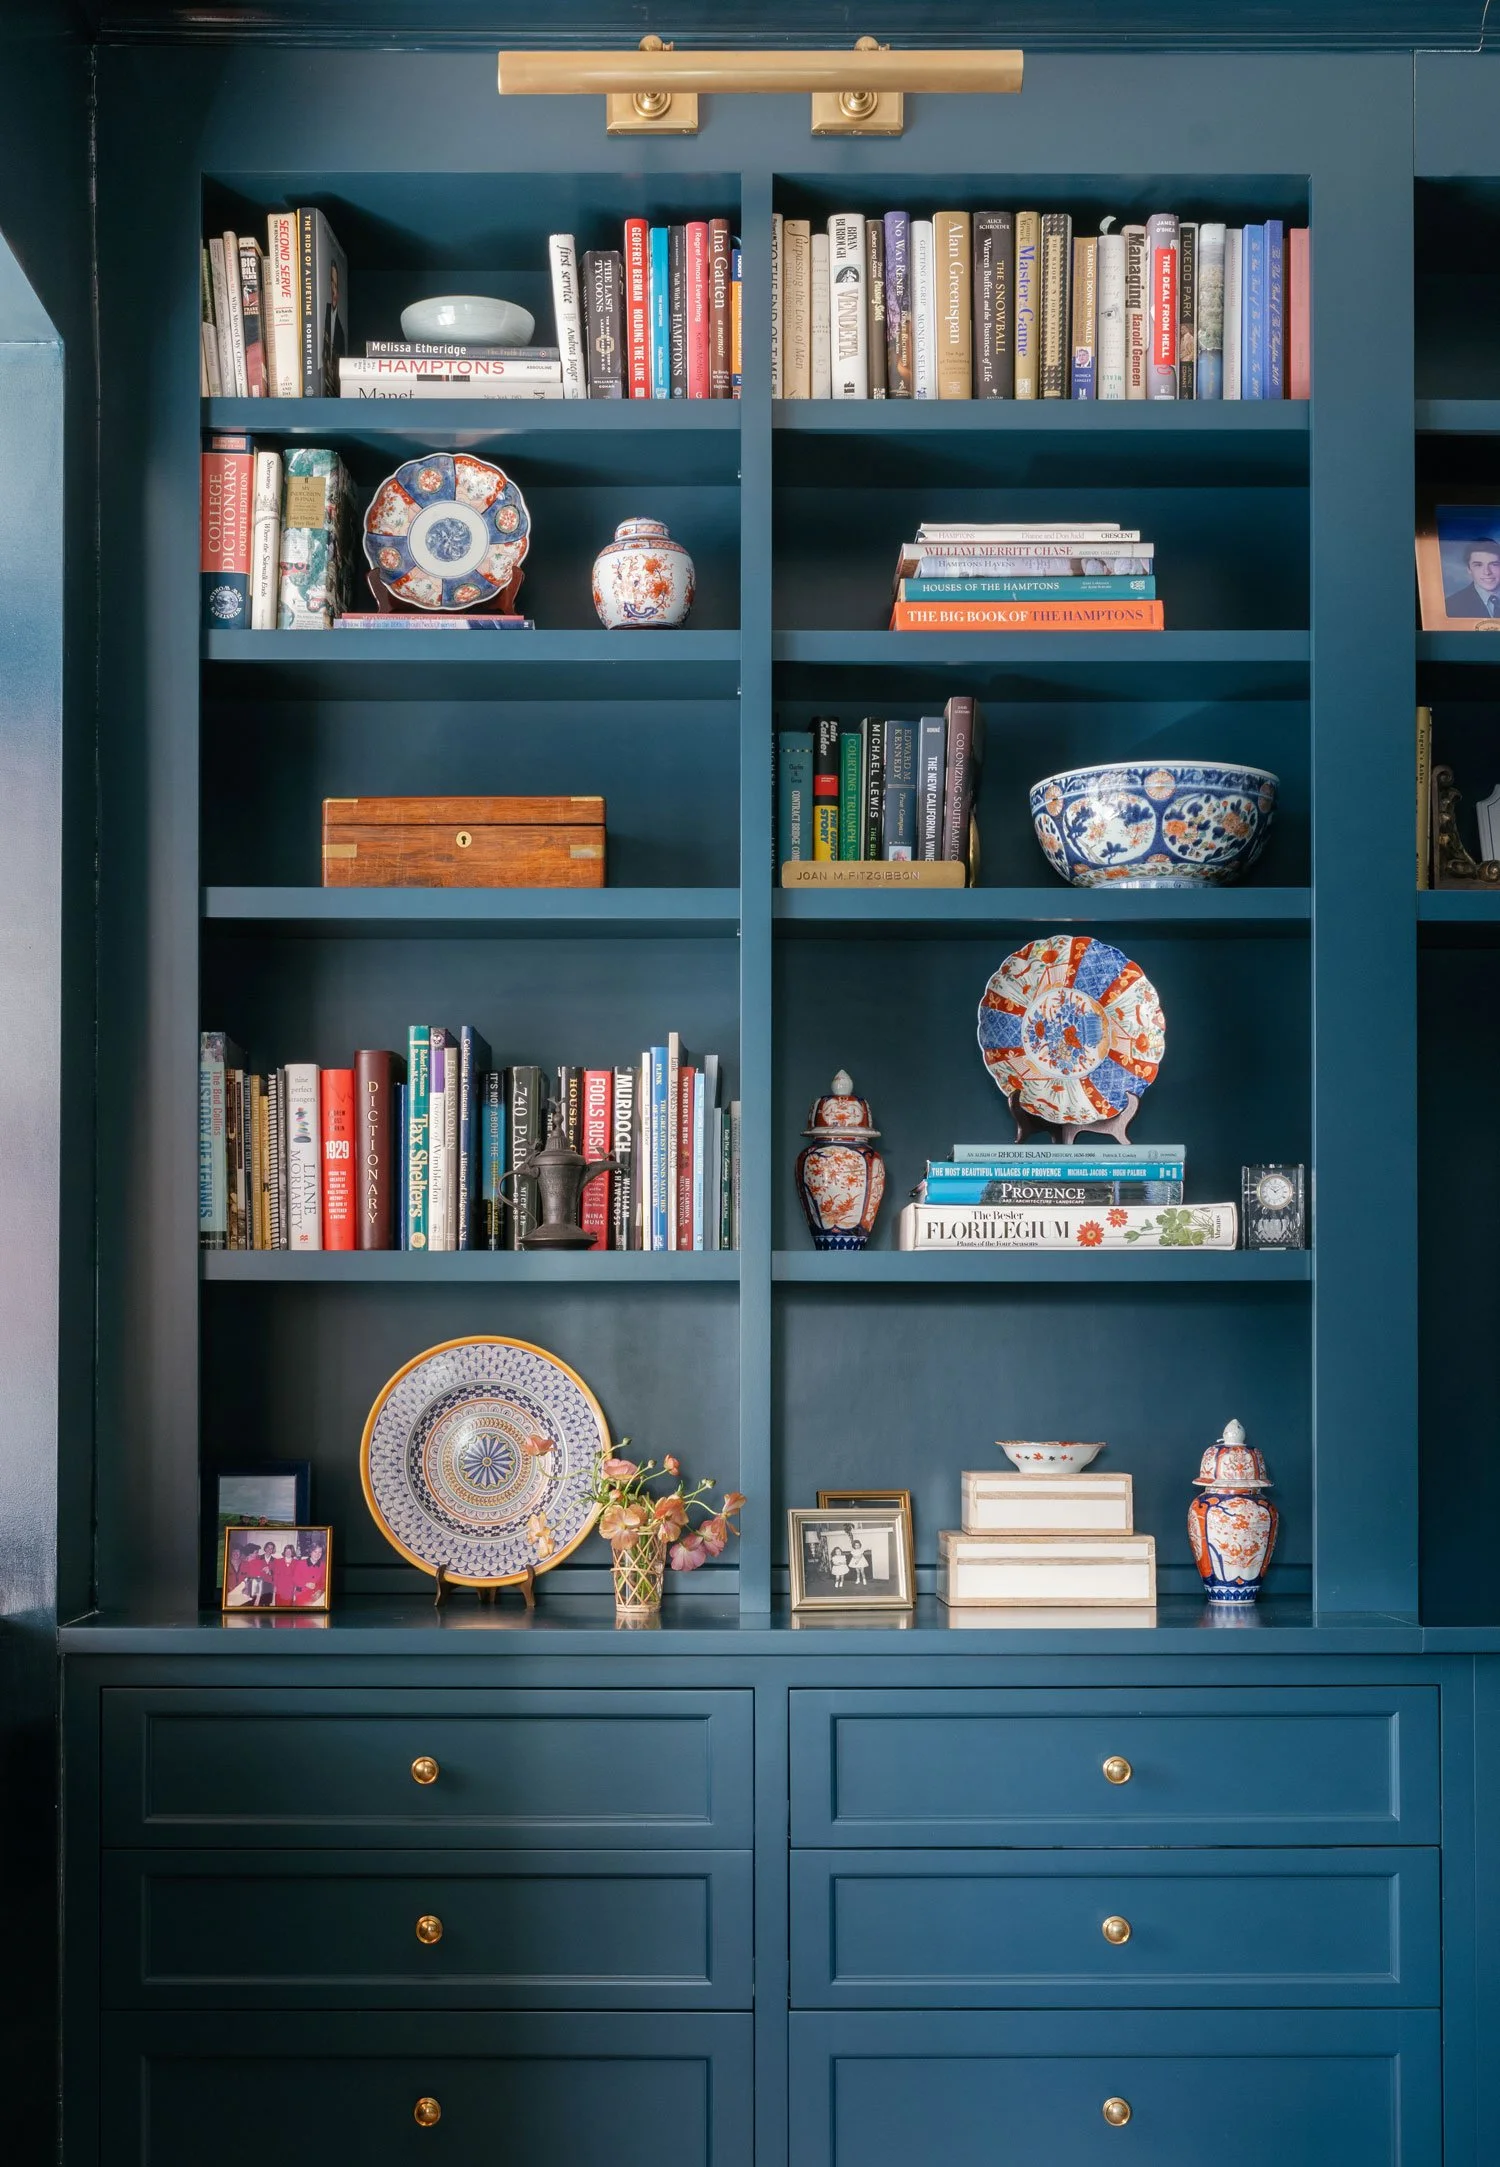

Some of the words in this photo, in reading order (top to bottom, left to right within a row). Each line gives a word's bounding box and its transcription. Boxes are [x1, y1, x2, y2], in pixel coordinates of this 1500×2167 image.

[280, 219, 290, 260] SECOND
[632, 227, 641, 266] GEOFFREY
[714, 229, 727, 252] Ina
[836, 218, 846, 259] BURROUGH
[949, 221, 963, 257] Alan
[984, 238, 992, 268] Warren
[305, 257, 311, 268] OF
[556, 245, 572, 267] first
[786, 223, 808, 288] Surpassing
[996, 260, 1005, 279] THE
[1125, 232, 1145, 308] Managing
[1183, 233, 1192, 282] TUXEDO
[280, 262, 292, 298] SERVE
[562, 271, 573, 304] service
[594, 260, 603, 312] TYCOONS
[633, 269, 642, 301] BERMAN
[714, 257, 728, 308] Garten
[1019, 245, 1035, 302] Master
[232, 296, 240, 312] Who
[796, 291, 805, 305] the
[945, 262, 964, 344] Greenspan
[233, 314, 241, 336] Moved
[633, 309, 643, 343] HOLDING
[796, 309, 805, 332] Love
[837, 288, 859, 361] VENDETTA
[995, 283, 1006, 355] SNOWBALL
[1018, 308, 1034, 357] Game
[1132, 313, 1142, 346] Harold
[234, 338, 242, 349] My
[372, 342, 411, 353] Melissa
[415, 344, 467, 355] Etheridge
[566, 328, 576, 355] Andrea
[634, 346, 644, 360] THE
[795, 335, 806, 345] of
[1162, 333, 1170, 358] HELL
[236, 350, 244, 381] Cheese?
[378, 359, 504, 374] HAMPTONS
[567, 356, 578, 382] Jaeger
[635, 362, 644, 381] LINE
[796, 349, 804, 369] Men
[984, 358, 992, 366] of
[984, 366, 993, 382] Life
[1132, 349, 1141, 386] Geneen
[240, 472, 248, 519] EDITION
[209, 474, 222, 552] COLLEGE
[223, 458, 237, 571] DICTIONARY
[240, 521, 248, 557] FOURTH
[263, 523, 271, 542] Where
[925, 547, 976, 556] WILLIAM
[979, 547, 1031, 556] MERRITT
[1034, 547, 1073, 556] CHASE
[261, 582, 270, 597] Ends
[922, 584, 962, 592] HOUSES
[965, 583, 979, 592] OF
[982, 583, 1000, 591] THE
[1004, 582, 1059, 591] HAMPTONS
[907, 611, 937, 622] THE
[940, 611, 965, 622] BIG
[967, 611, 1007, 622] BOOK
[1008, 610, 1027, 622] OF
[1031, 610, 1060, 621] THE
[1062, 610, 1143, 621] HAMPTONS
[820, 721, 829, 756] Calder
[871, 724, 880, 776] MICHAEL
[847, 738, 856, 792] COURTING
[894, 729, 902, 780] KENNEDY
[927, 756, 937, 771] THE
[954, 733, 964, 793] COLONIZING
[903, 771, 911, 781] M.
[927, 773, 937, 792] NEW
[871, 782, 879, 818] LEWIS
[847, 795, 856, 842] TRIUMPH
[926, 793, 936, 840] CALIFORNIA
[926, 842, 935, 861] WINE
[796, 872, 827, 880] JOAN
[834, 872, 846, 880] M.
[848, 872, 920, 880] FITZGIBBON
[213, 1071, 222, 1085] The
[213, 1088, 222, 1104] Bud
[514, 1087, 527, 1116] 740
[569, 1078, 577, 1126] HOUSE
[589, 1078, 605, 1117] FOOLS
[213, 1108, 222, 1136] Collins
[616, 1074, 633, 1152] MURDOCH
[409, 1114, 428, 1145] Tax
[325, 1141, 349, 1159] 1929
[367, 1081, 379, 1224] DICTIONARY
[409, 1149, 428, 1218] Shelters
[931, 1168, 943, 1177] THE
[944, 1168, 960, 1177] MOST
[961, 1168, 992, 1177] BEAUTIFUL
[994, 1168, 1020, 1177] VILLAGES
[1022, 1168, 1030, 1177] OF
[1031, 1168, 1061, 1177] PROVENCE
[290, 1150, 302, 1230] MORIARTY
[304, 1163, 316, 1215] LIANE
[614, 1169, 622, 1226] SHAWCROSS
[622, 1177, 630, 1218] WILLIAM
[1001, 1182, 1085, 1200] PROVENCE
[927, 1221, 1069, 1239] FLORILEGIUM
[971, 1211, 990, 1220] The
[993, 1211, 1023, 1220] Besler
